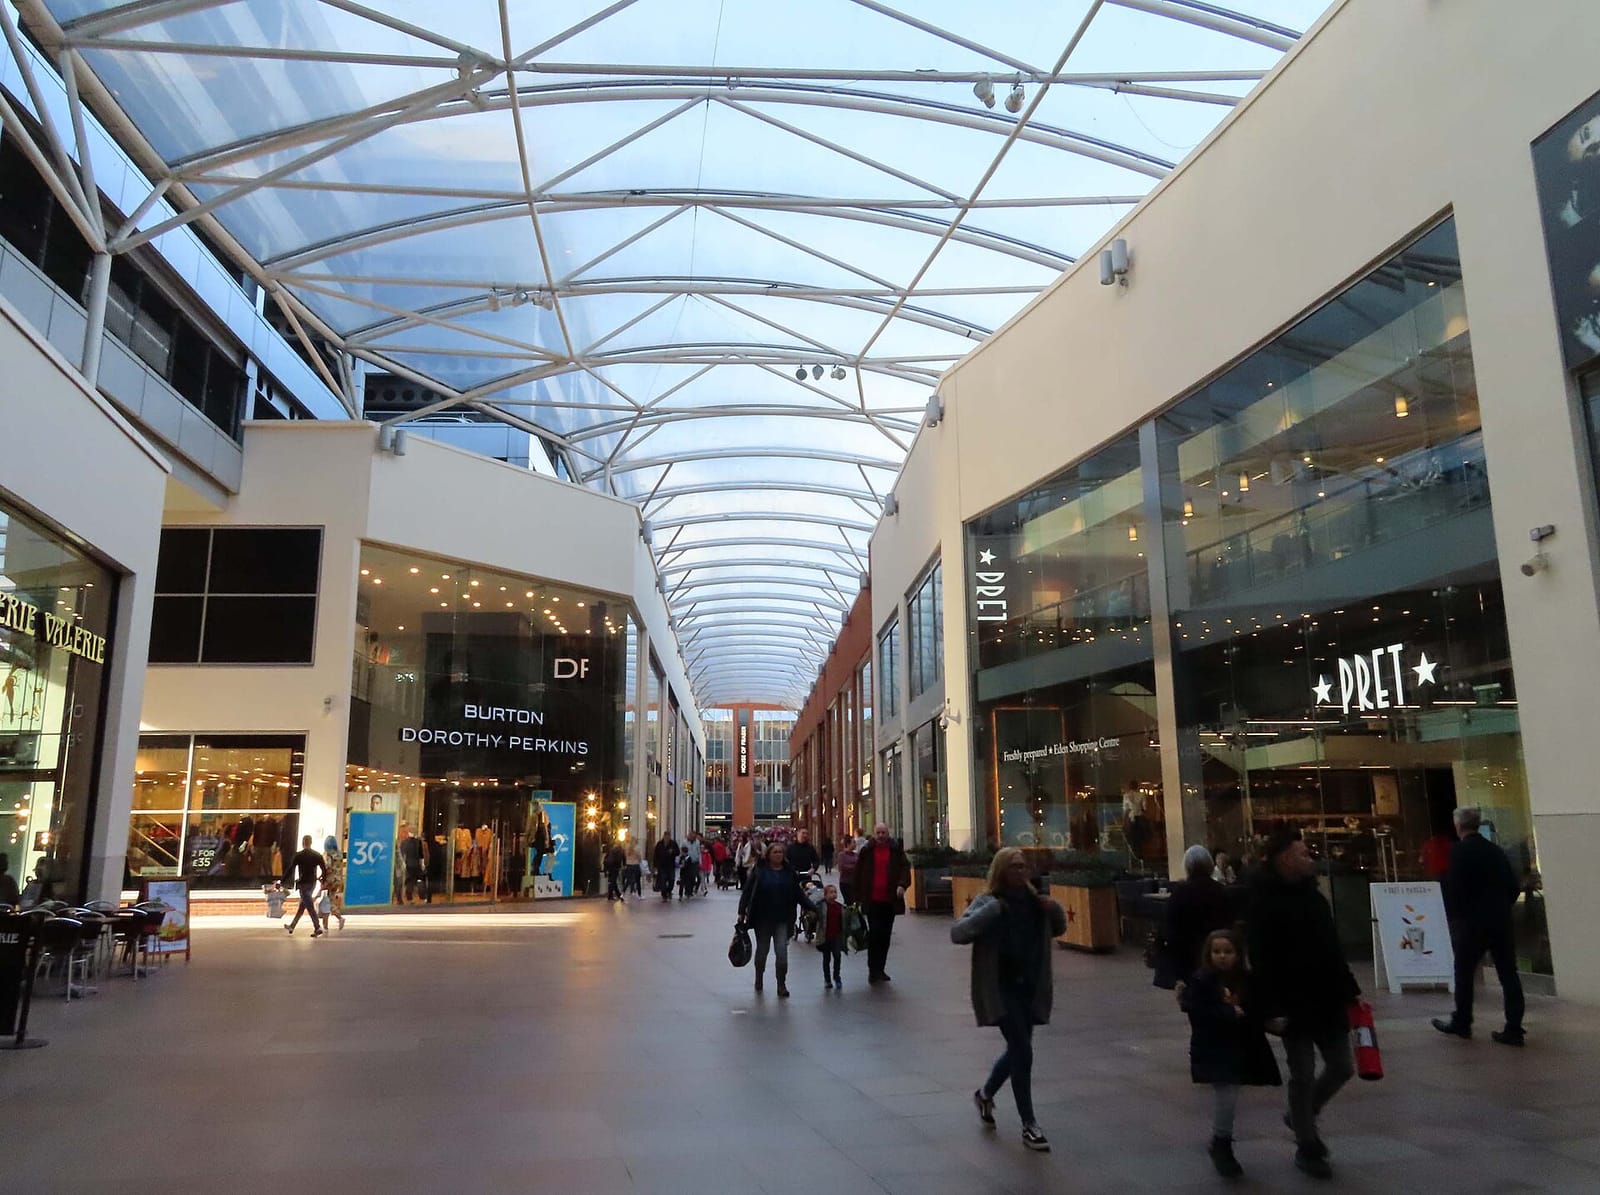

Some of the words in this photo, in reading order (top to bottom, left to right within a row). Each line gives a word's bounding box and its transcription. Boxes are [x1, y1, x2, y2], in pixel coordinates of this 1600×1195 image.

[45, 611, 106, 664] VALERIE
[1338, 643, 1404, 715] PRET
[464, 704, 544, 725] BURTON
[402, 727, 502, 748] DOROTHY
[509, 736, 589, 755] PERKINS
[740, 746, 747, 755] OF
[1003, 749, 1022, 763] Freshly
[1023, 745, 1048, 762] prepared
[1053, 743, 1069, 755] Eden
[1069, 740, 1098, 754] Shopping
[1099, 737, 1120, 749] Centre
